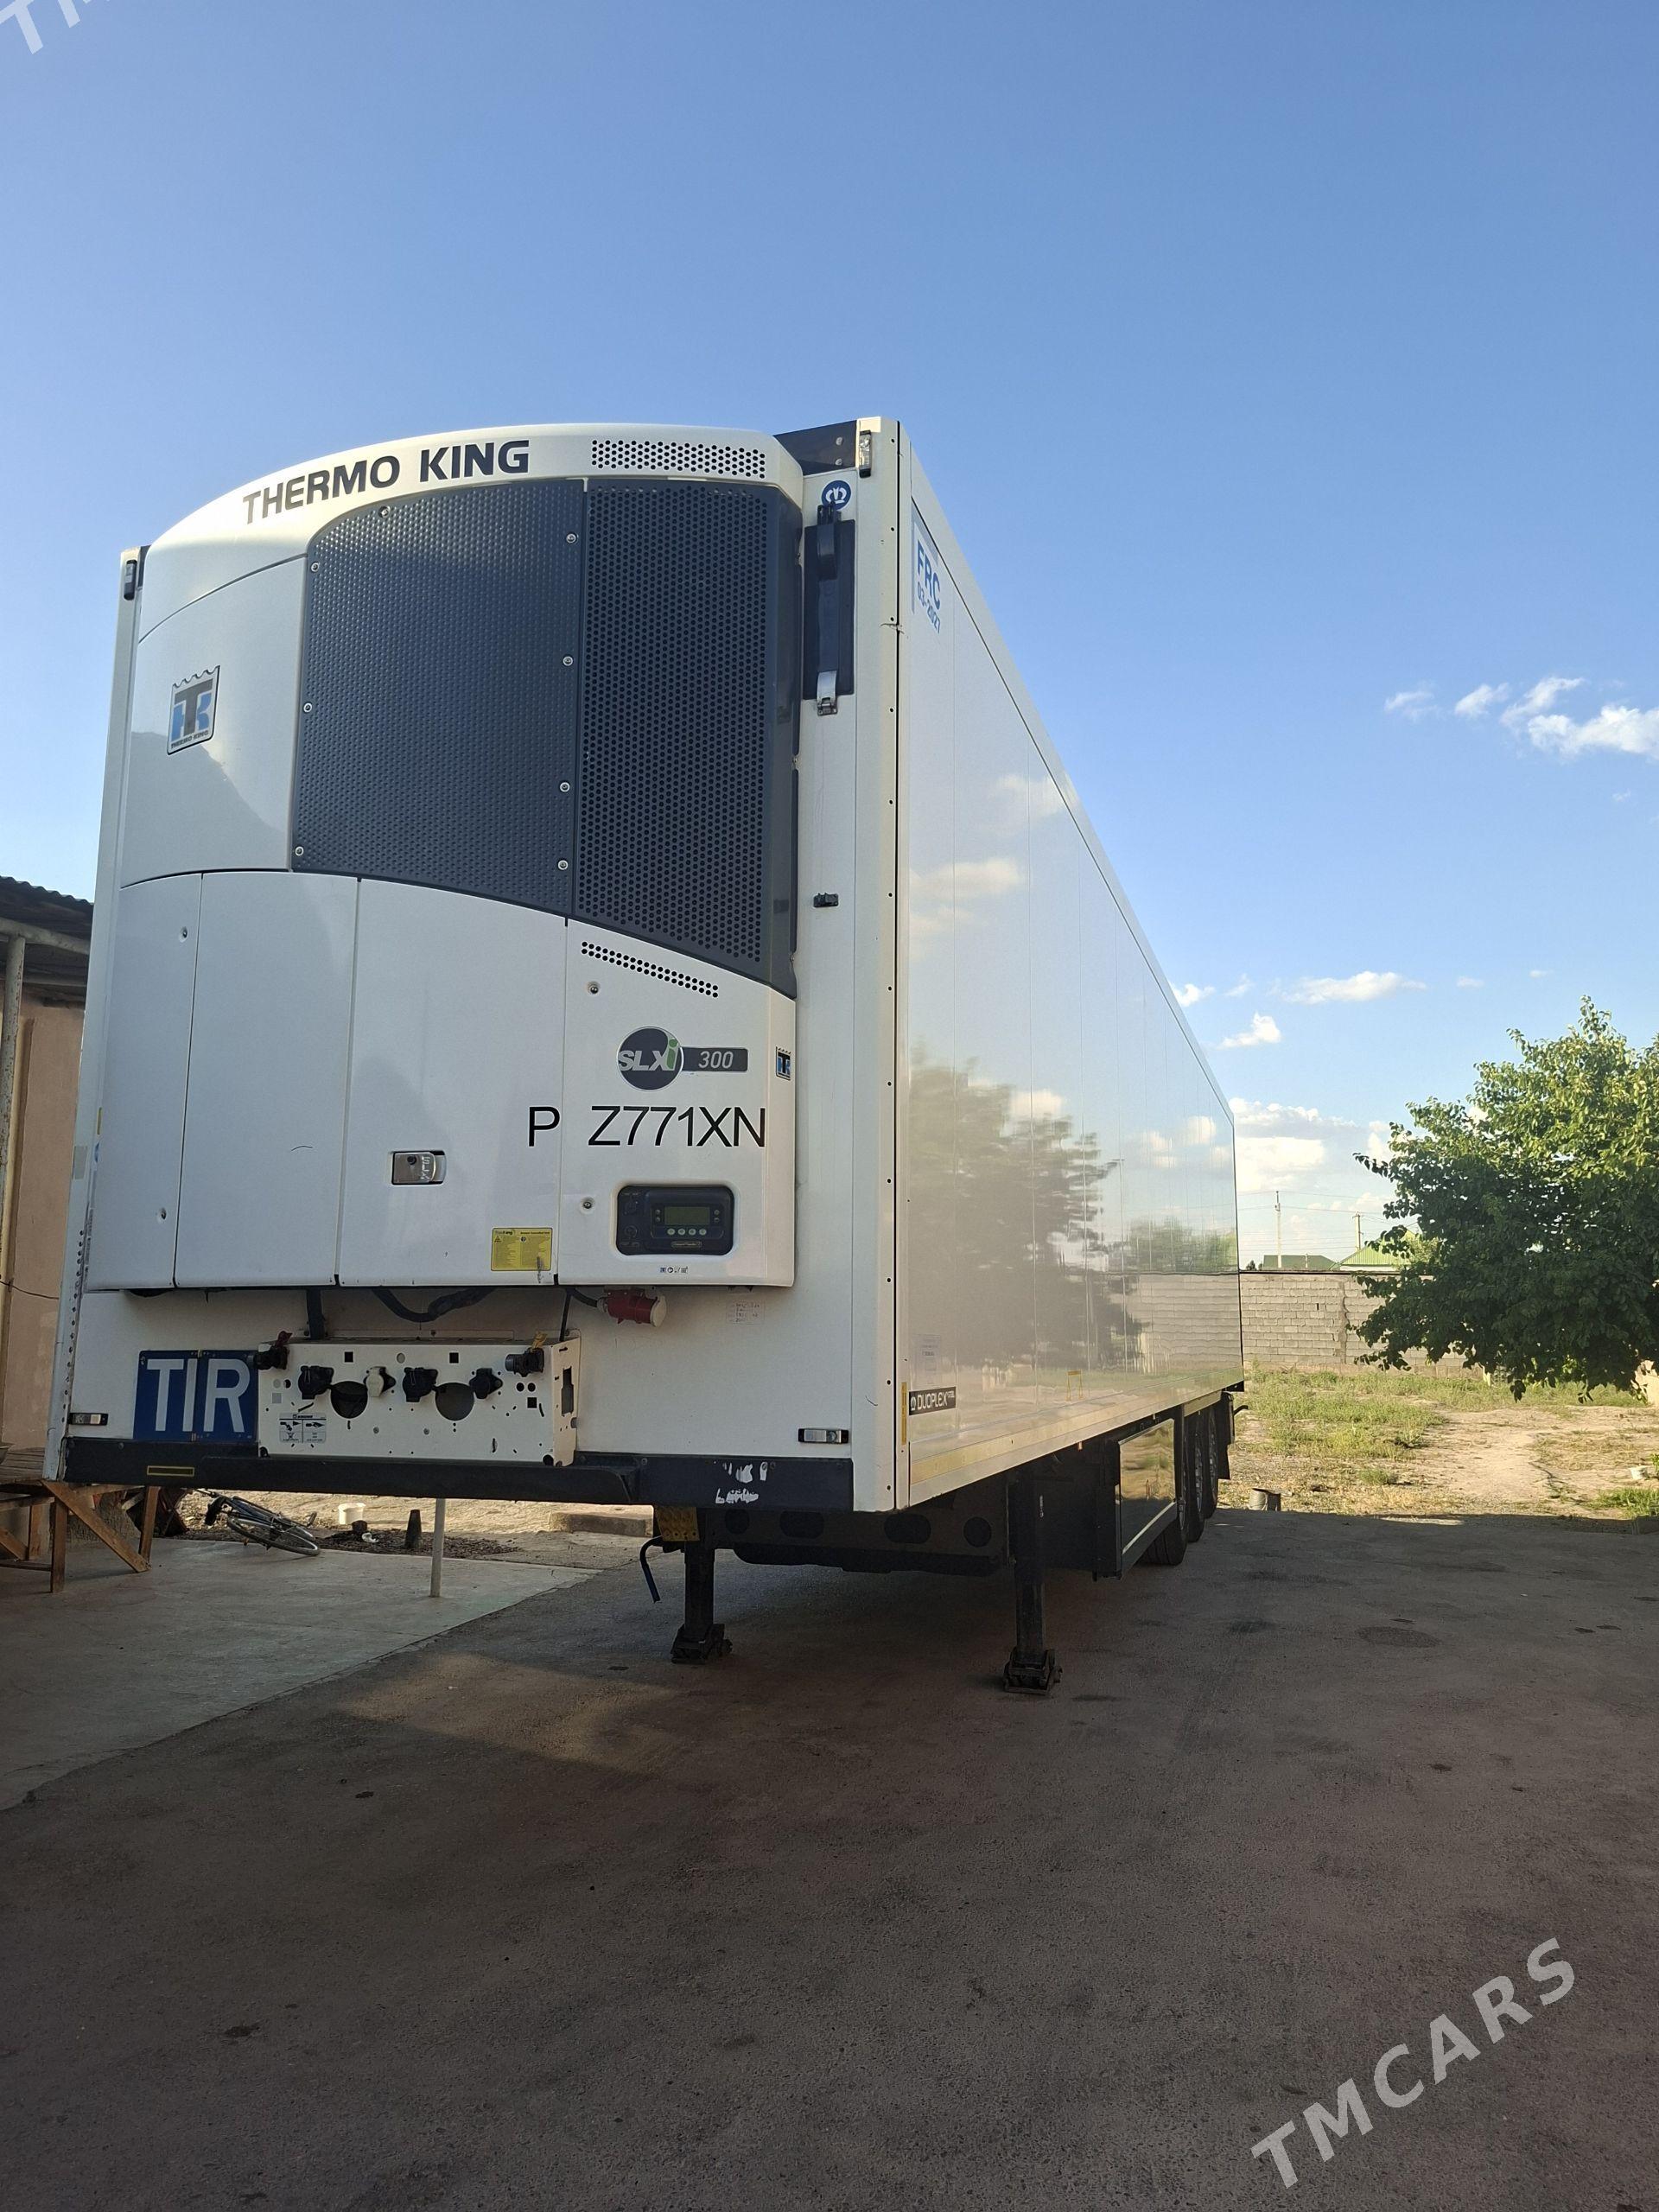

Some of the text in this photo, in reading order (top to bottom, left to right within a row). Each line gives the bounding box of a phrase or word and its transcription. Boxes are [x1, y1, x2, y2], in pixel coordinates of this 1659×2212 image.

[242, 440, 530, 524] THERMO KING
[917, 538, 941, 610] FRC
[698, 1051, 734, 1069] 300
[528, 1105, 766, 1147] P Z771XN
[146, 1358, 251, 1433] TIR
[917, 1392, 948, 1410] DUOPLEX
